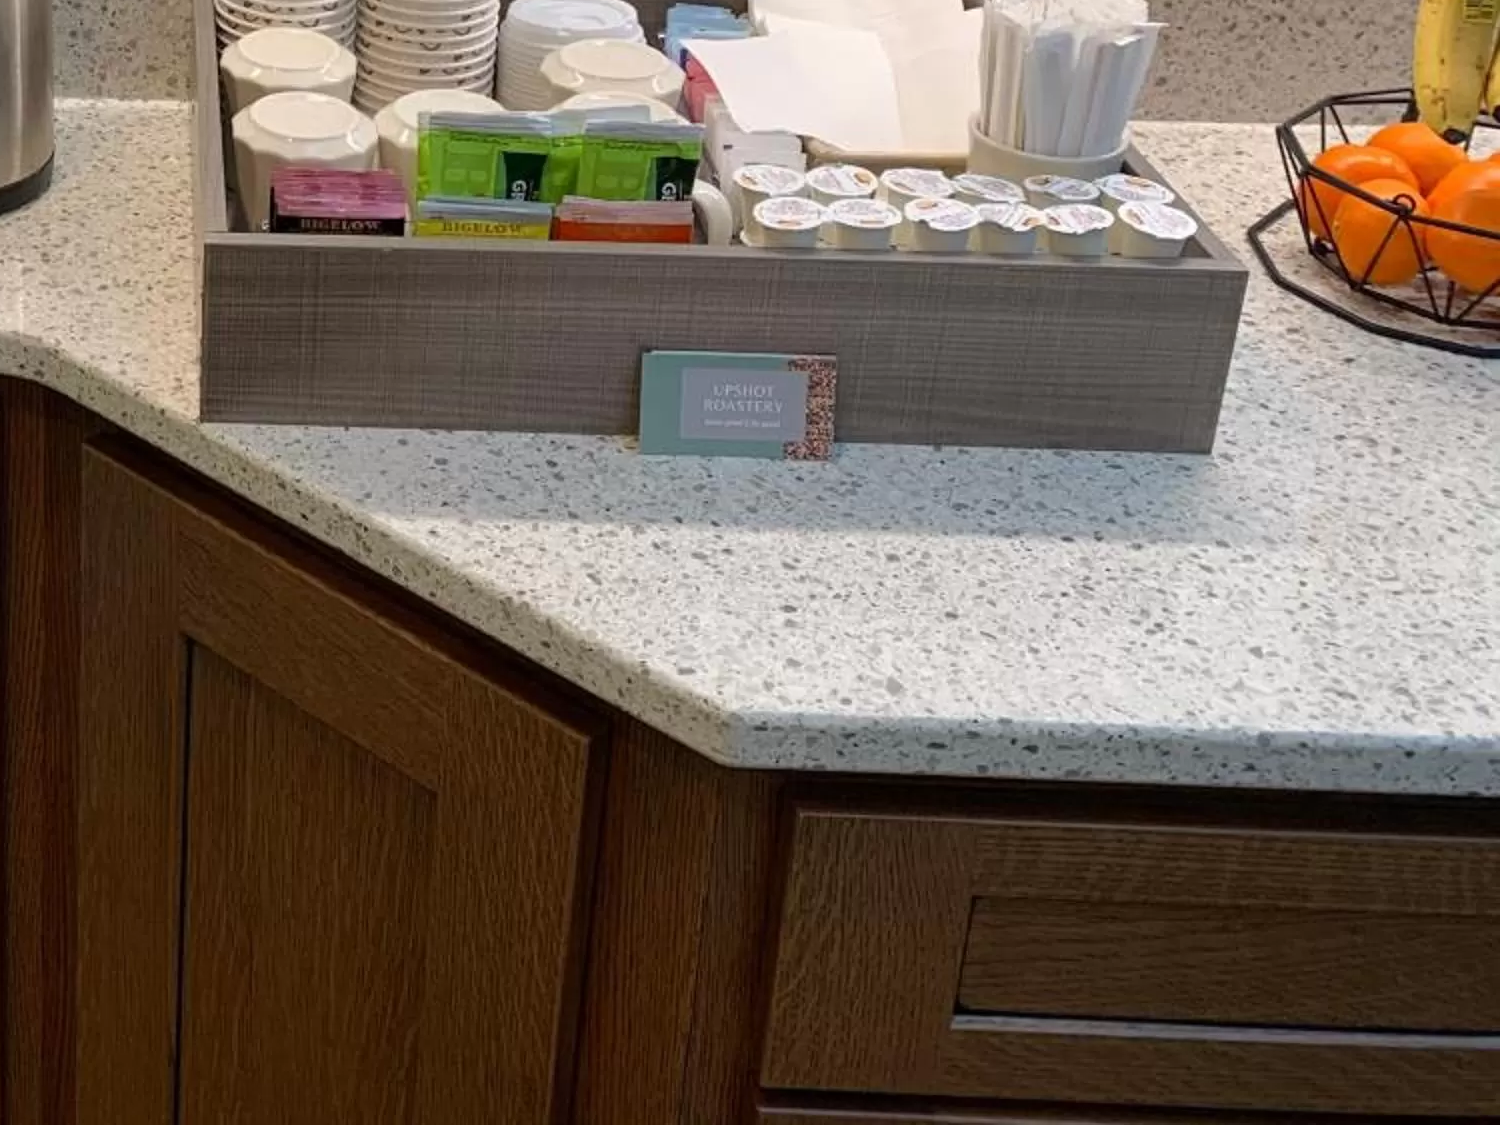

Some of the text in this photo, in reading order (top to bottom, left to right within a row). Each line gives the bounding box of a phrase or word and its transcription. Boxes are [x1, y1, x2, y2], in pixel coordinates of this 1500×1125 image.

[300, 217, 381, 231] BIGELOW
[442, 221, 527, 235] BIGELOW
[712, 383, 775, 398] UPSHOT
[702, 398, 783, 413] ROASTERY
